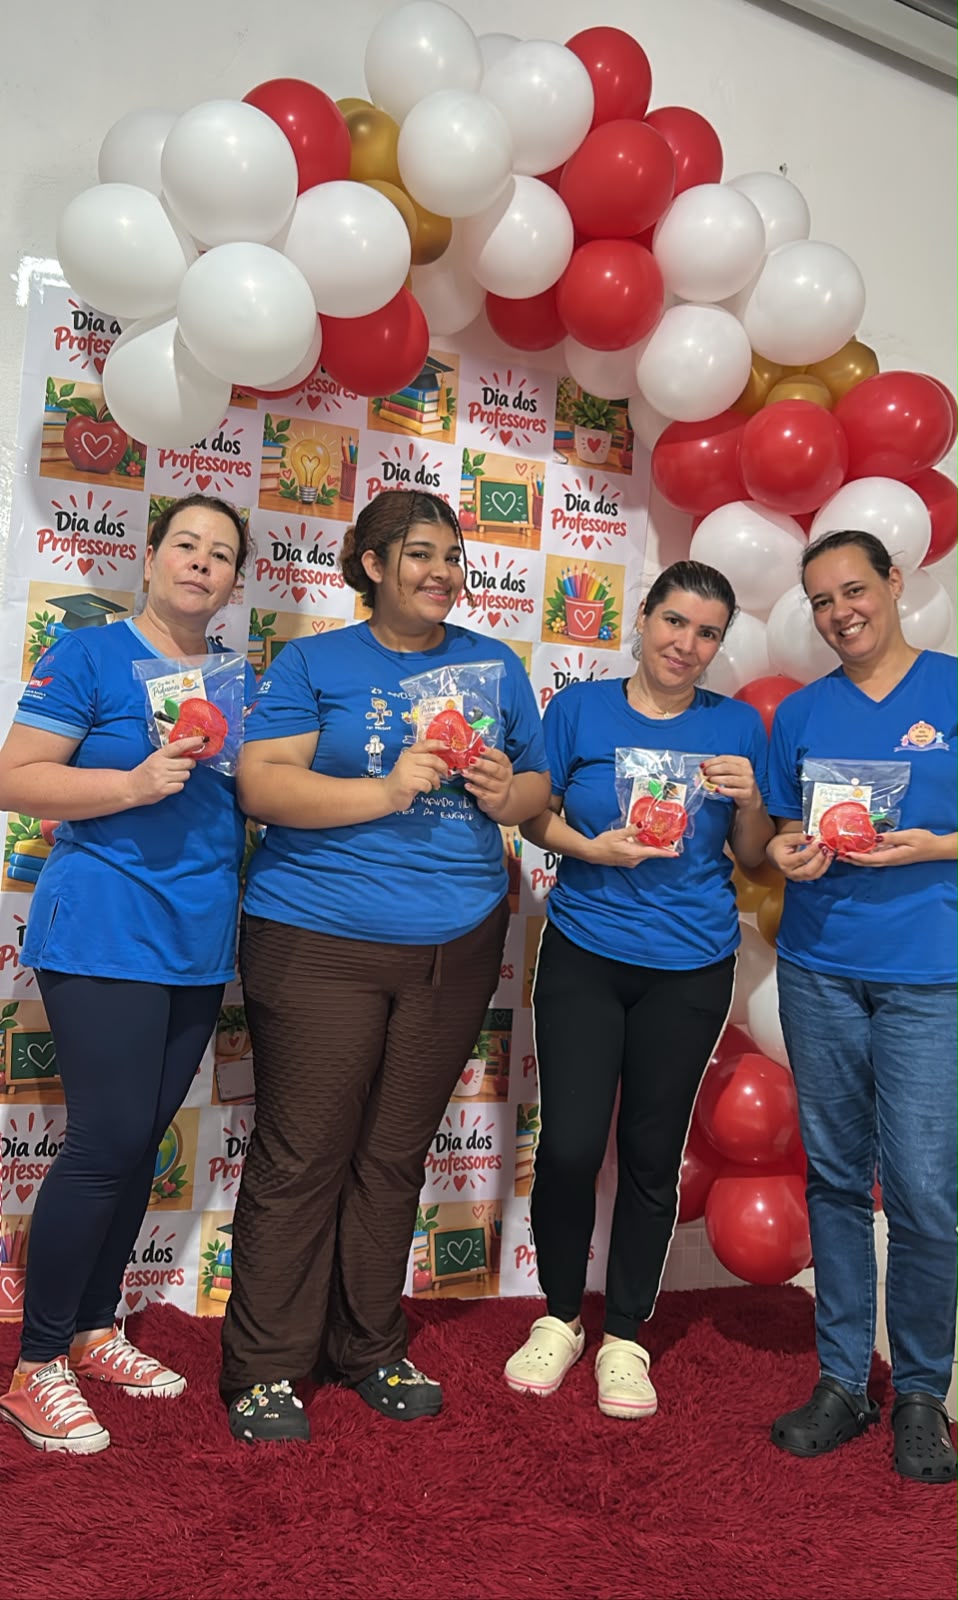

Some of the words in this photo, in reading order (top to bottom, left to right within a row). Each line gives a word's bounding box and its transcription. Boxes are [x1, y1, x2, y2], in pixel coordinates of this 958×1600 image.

[71, 310, 106, 333] Dia
[481, 386, 510, 409] Dia
[512, 390, 537, 413] dos
[468, 401, 547, 434] Professores
[212, 431, 241, 455] dos
[381, 461, 411, 482] Dia
[414, 464, 441, 487] dos
[564, 493, 591, 515] Dia
[593, 494, 619, 517] dos
[54, 510, 90, 533] Dia
[93, 513, 125, 538] dos
[550, 508, 628, 538] Professores
[37, 528, 137, 561] Professores
[271, 541, 303, 563] Dia
[306, 543, 335, 567] dos
[255, 558, 345, 589] Professores
[470, 569, 498, 591] Dia
[500, 570, 526, 594] dos
[434, 1132, 463, 1153] Dia
[466, 1129, 493, 1150] dos
[142, 1240, 174, 1264] dos
